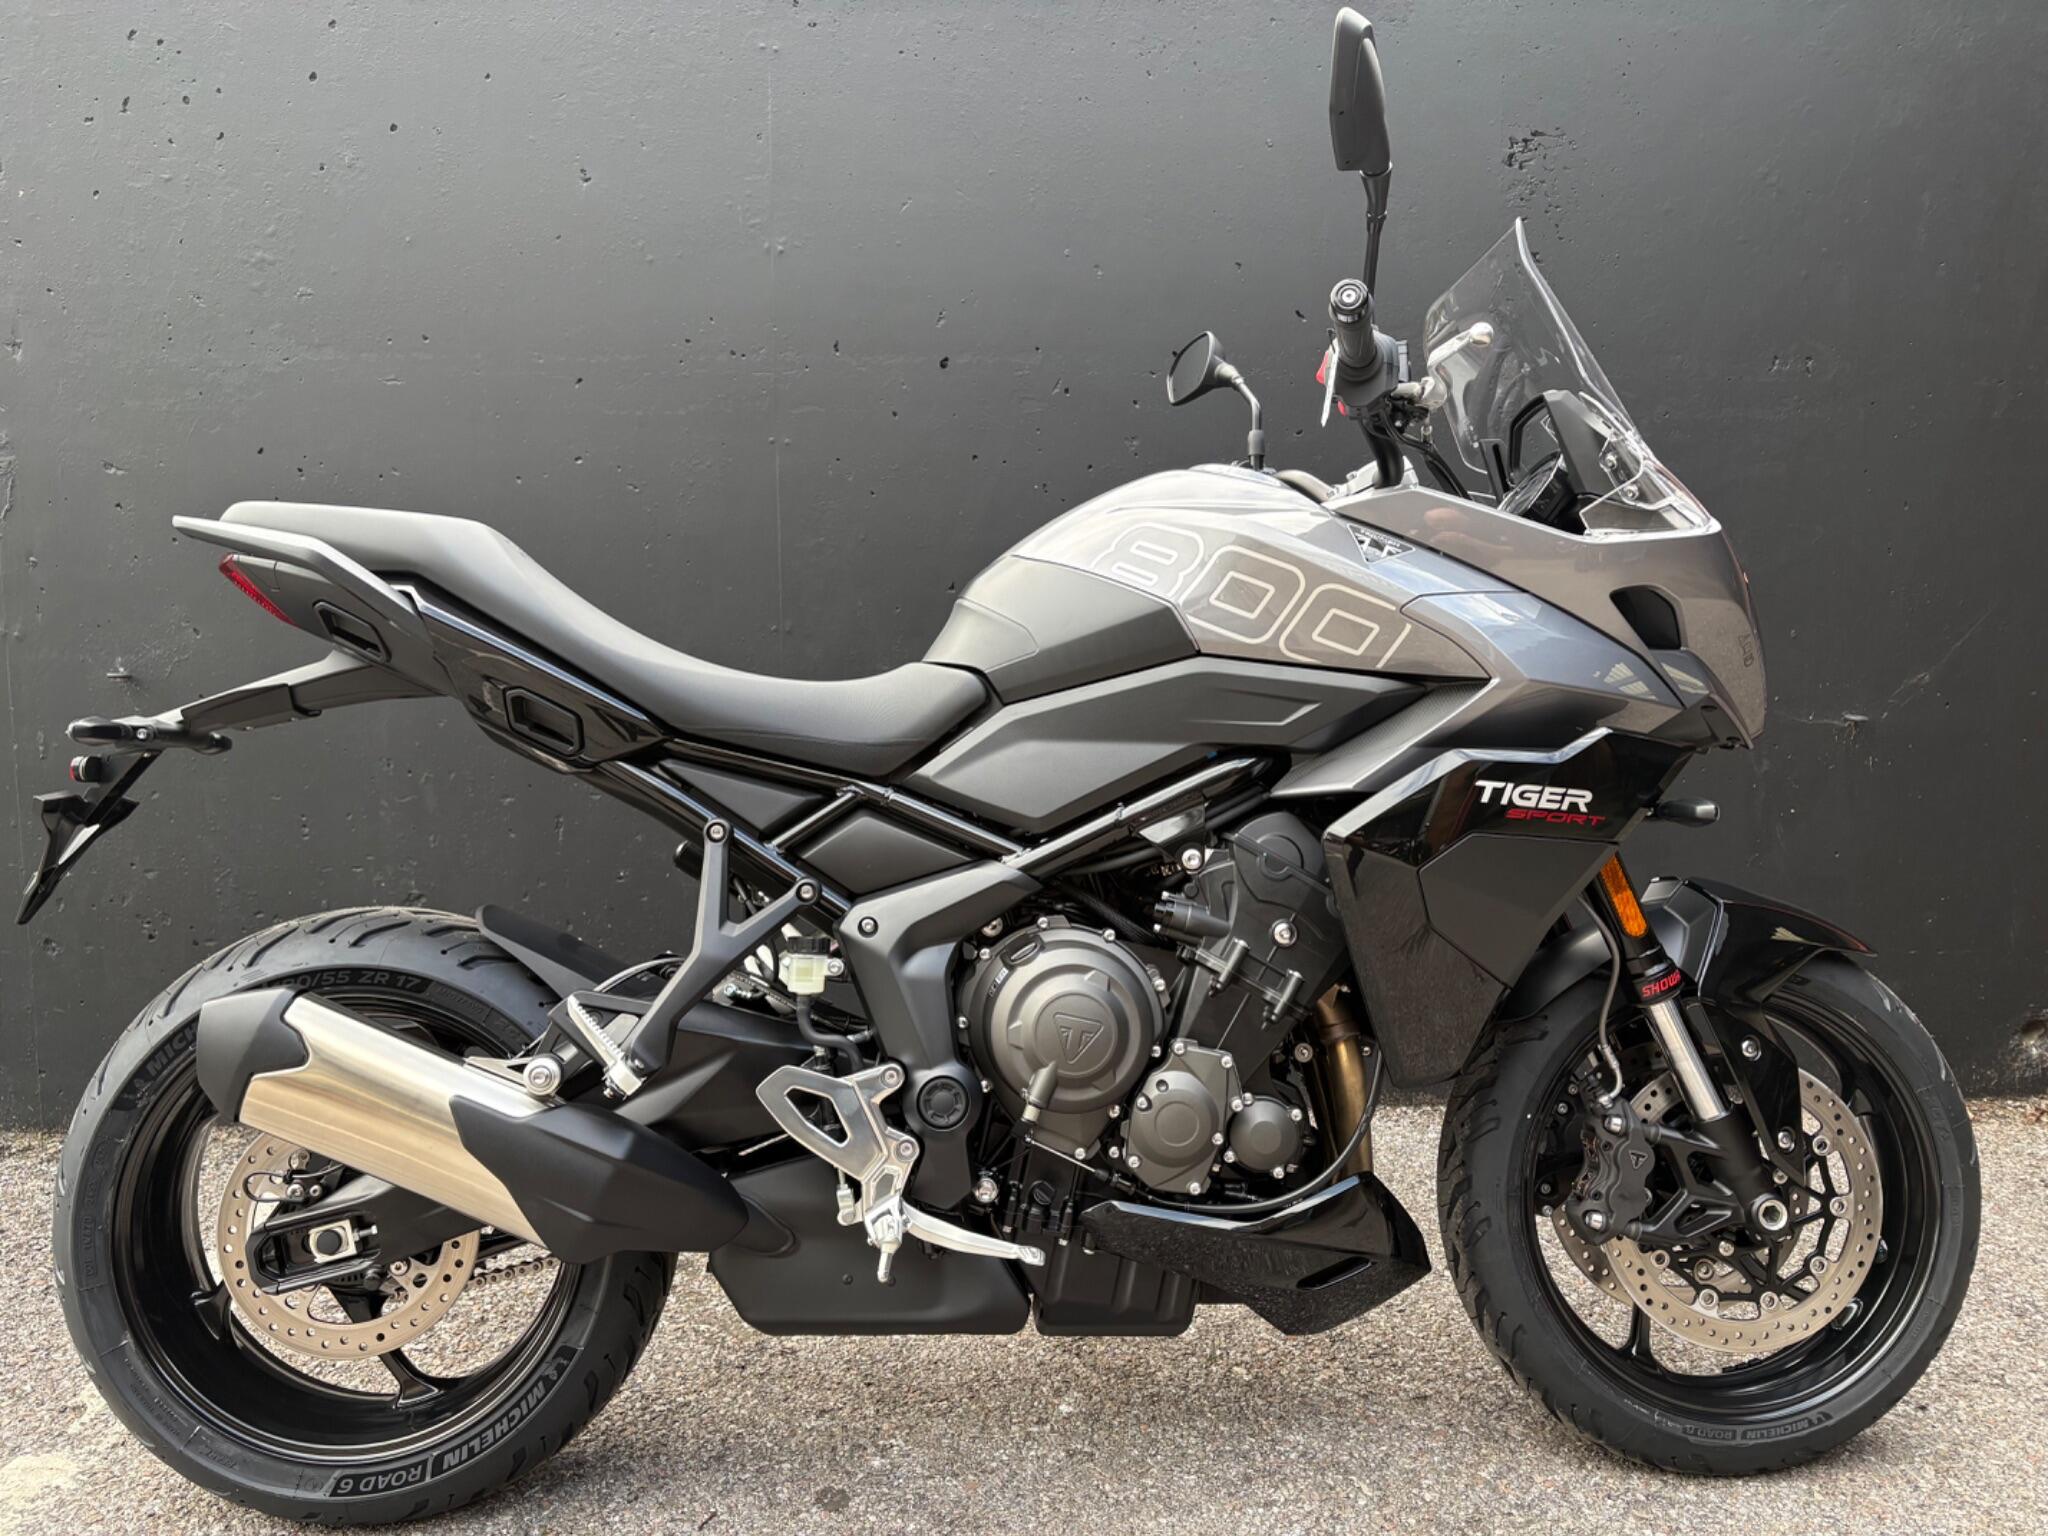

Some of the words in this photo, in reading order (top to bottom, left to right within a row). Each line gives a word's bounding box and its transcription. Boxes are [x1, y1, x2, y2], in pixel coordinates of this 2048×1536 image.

[1091, 521, 1412, 669] 800
[1475, 779, 1593, 814] TIGER
[1504, 808, 1606, 827] SPORT
[358, 971, 390, 985] ZR
[397, 975, 421, 989] 17
[145, 1022, 198, 1077] MICH
[442, 1383, 546, 1472] MICHELIN
[1693, 1427, 1733, 1440] ROAD
[1746, 1418, 1809, 1439] MICHELIN
[336, 1478, 350, 1494] 6
[360, 1466, 423, 1493] ROAD
